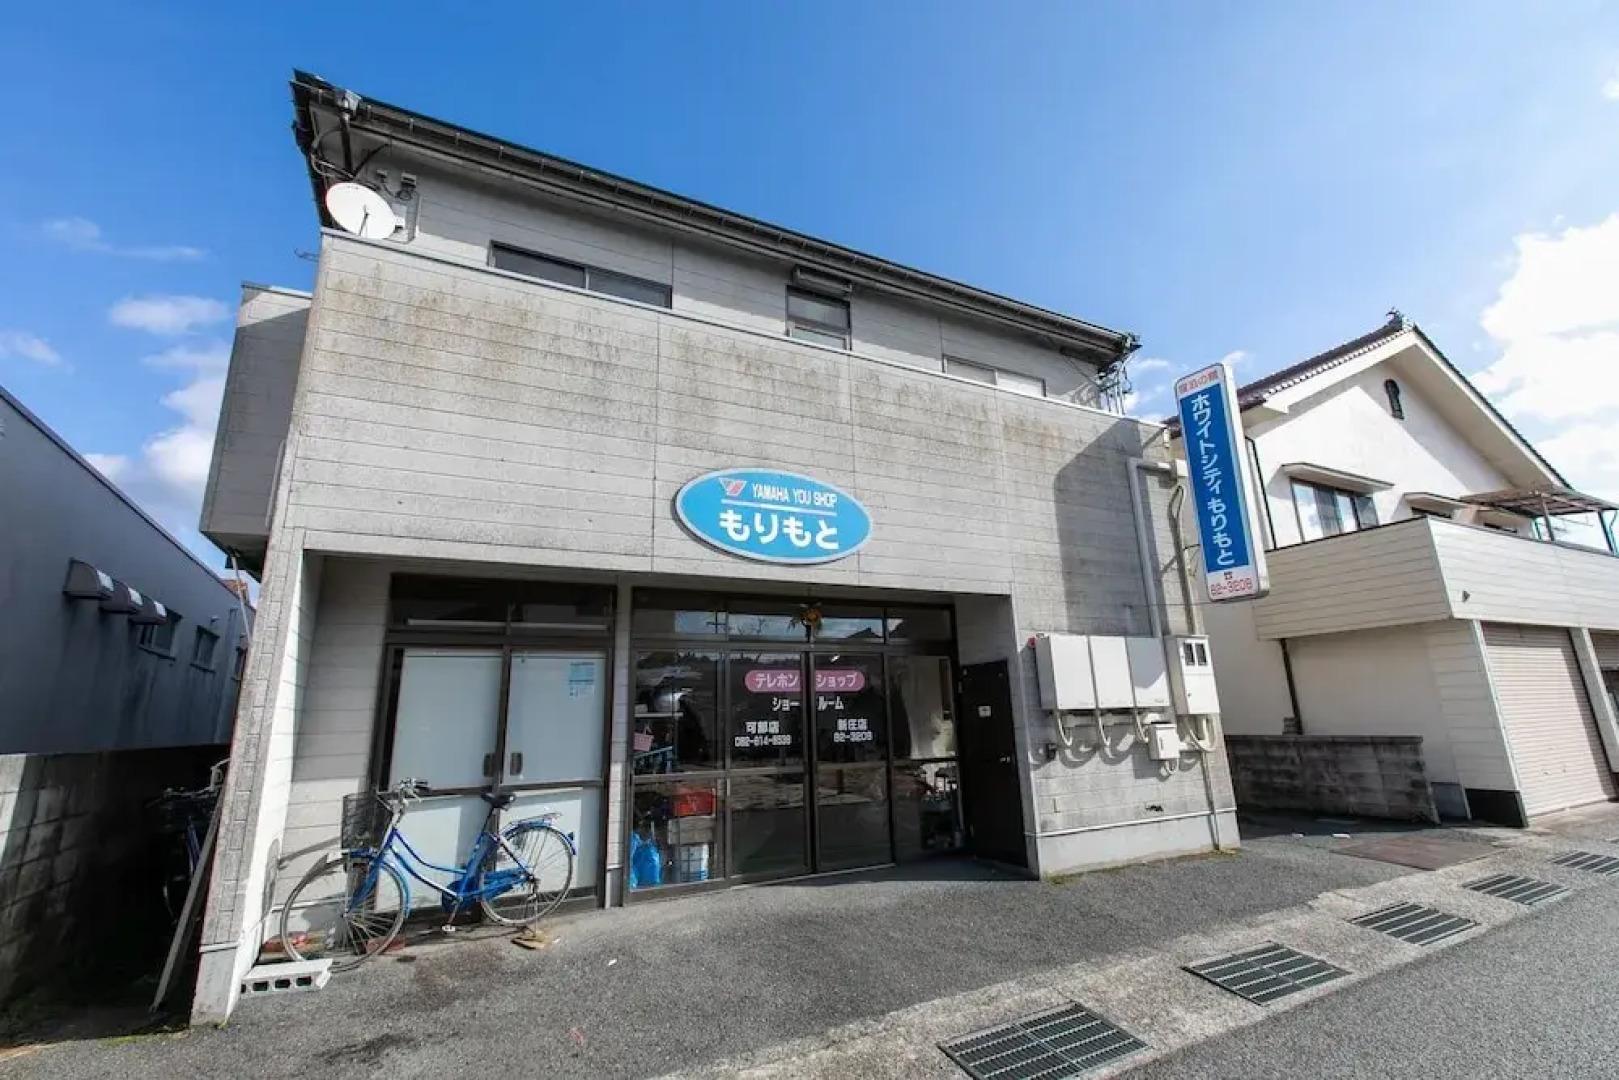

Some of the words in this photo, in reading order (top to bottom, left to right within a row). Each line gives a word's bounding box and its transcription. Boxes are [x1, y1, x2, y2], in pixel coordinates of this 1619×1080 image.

[752, 483, 790, 503] YAMAHA
[793, 489, 812, 505] YOU
[813, 492, 838, 508] SHOP
[719, 509, 840, 550] もりもと
[754, 672, 799, 690] テレホン
[815, 671, 858, 689] ショップ
[817, 695, 845, 711] ルーム
